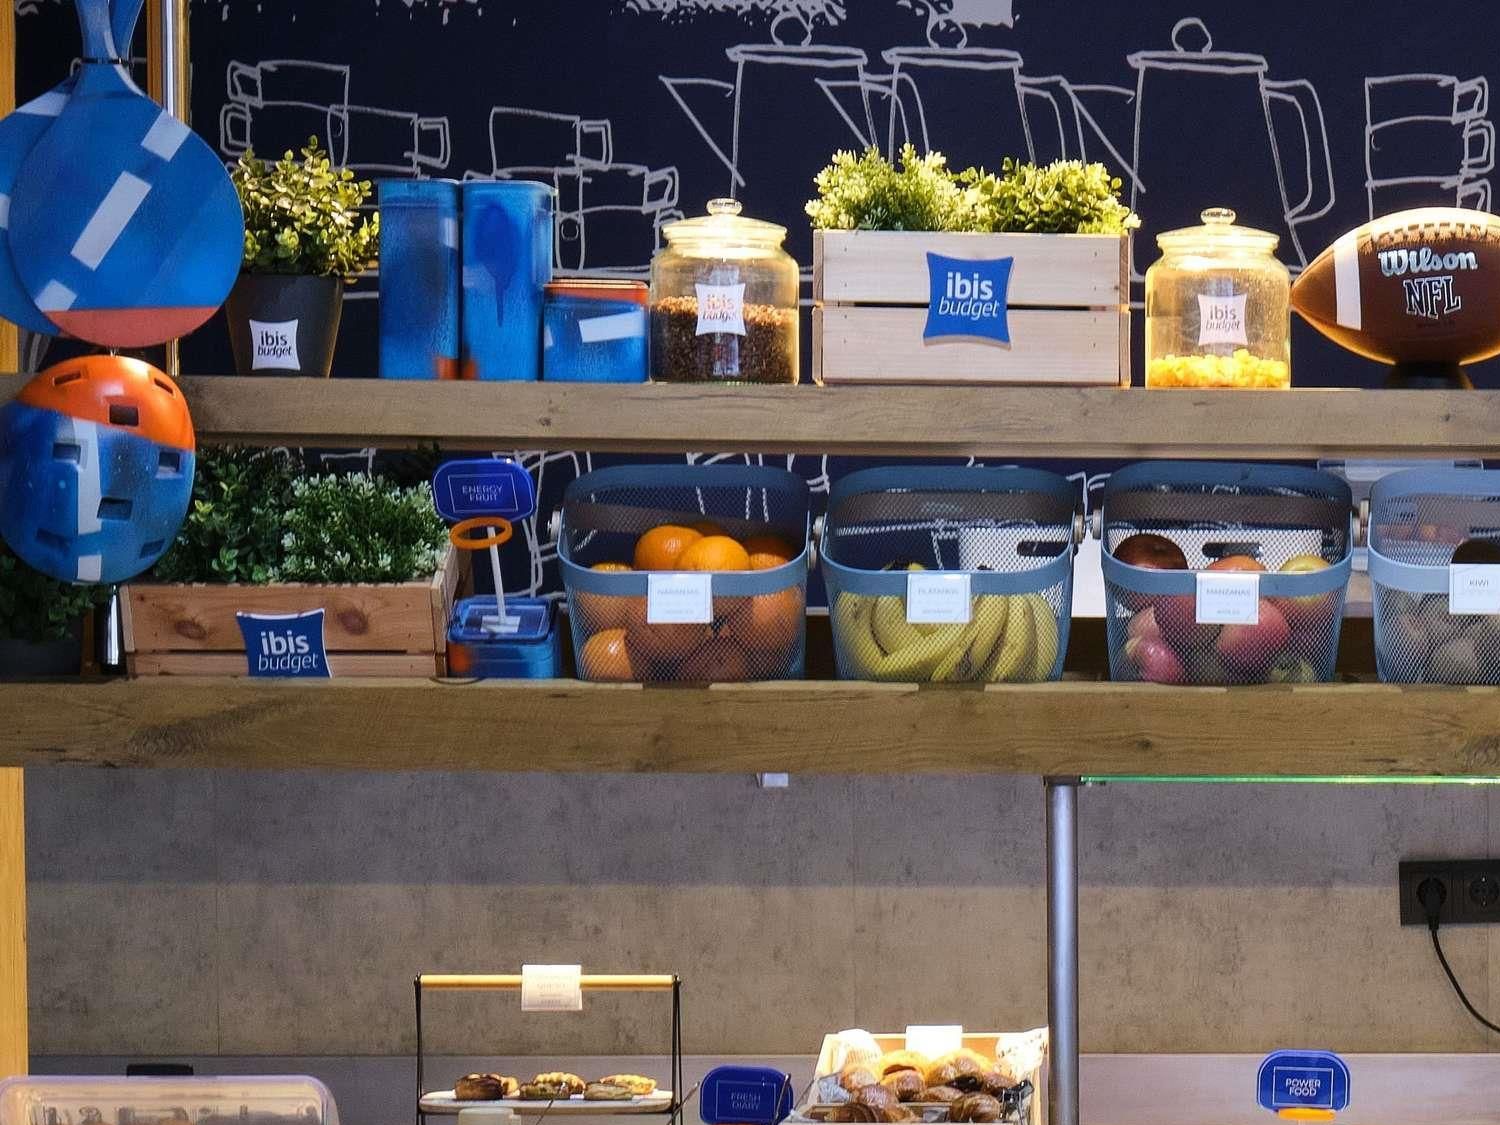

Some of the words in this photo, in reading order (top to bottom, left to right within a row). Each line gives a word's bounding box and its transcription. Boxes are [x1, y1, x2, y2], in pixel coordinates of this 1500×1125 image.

[1377, 246, 1478, 278] Wilson
[946, 271, 993, 300] ibis
[707, 294, 735, 309] ibis
[1403, 275, 1461, 320] NFL
[938, 296, 1000, 321] budget
[1210, 304, 1237, 320] ibis
[1205, 319, 1240, 332] budget
[260, 330, 287, 346] ibis
[257, 344, 292, 358] budget
[462, 484, 503, 495] ENERGY
[469, 493, 498, 502] FRUIT
[260, 630, 310, 655] ibis
[258, 653, 319, 674] budget
[1285, 1078, 1321, 1088] POWER
[731, 1091, 761, 1101] FRESH
[1289, 1086, 1317, 1096] FOOD
